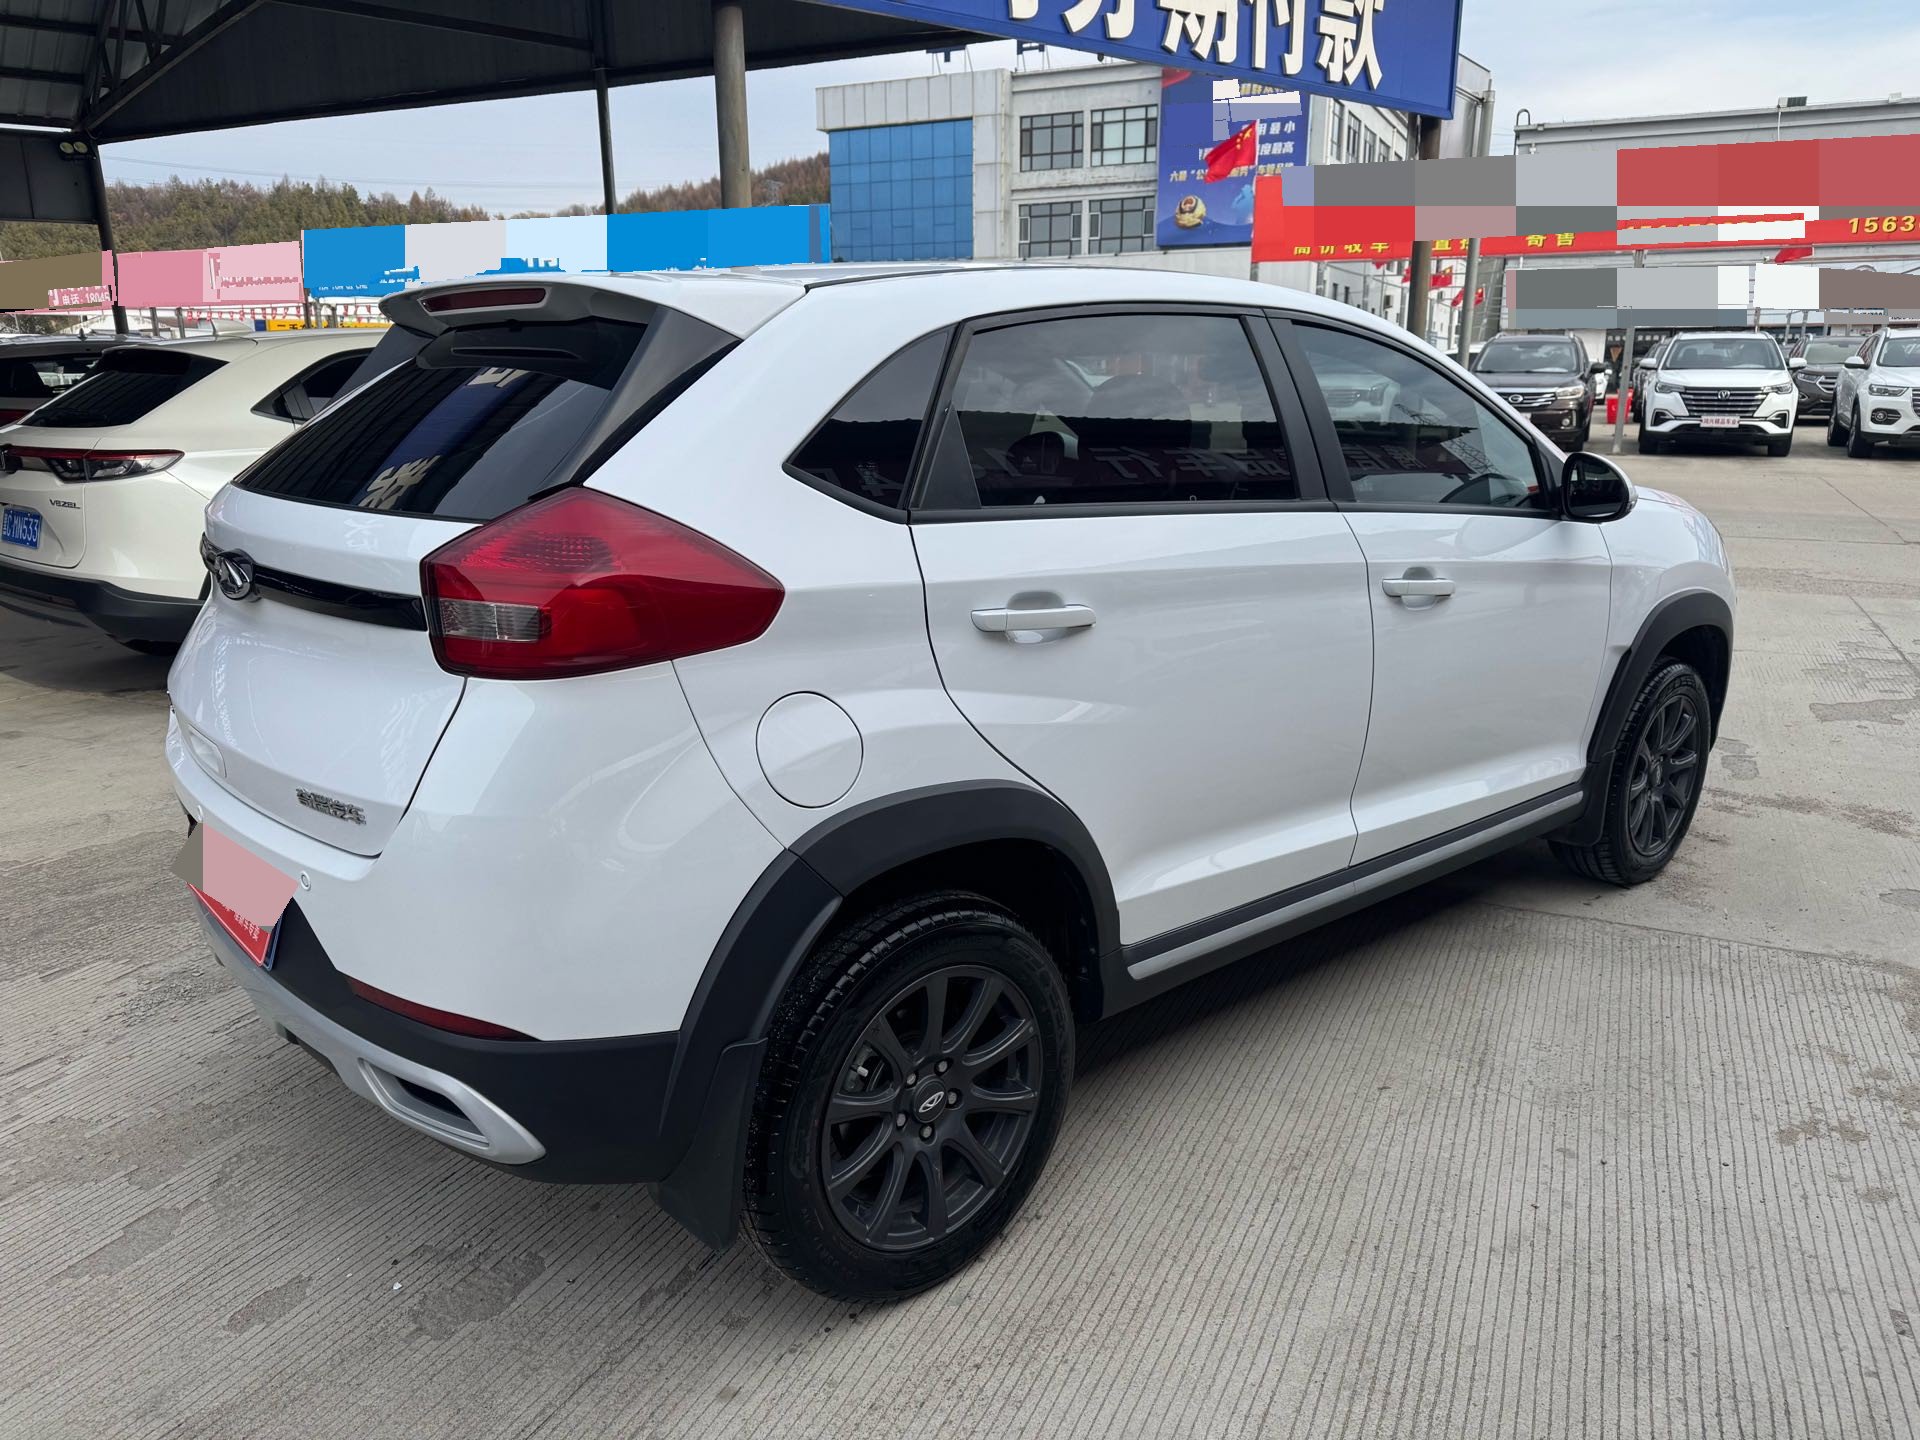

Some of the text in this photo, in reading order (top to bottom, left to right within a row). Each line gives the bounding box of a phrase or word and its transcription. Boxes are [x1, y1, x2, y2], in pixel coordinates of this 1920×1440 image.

[1009, 0, 1383, 91] 期付款
[1848, 215, 1920, 234] 1563
[49, 498, 81, 509] VEZEL
